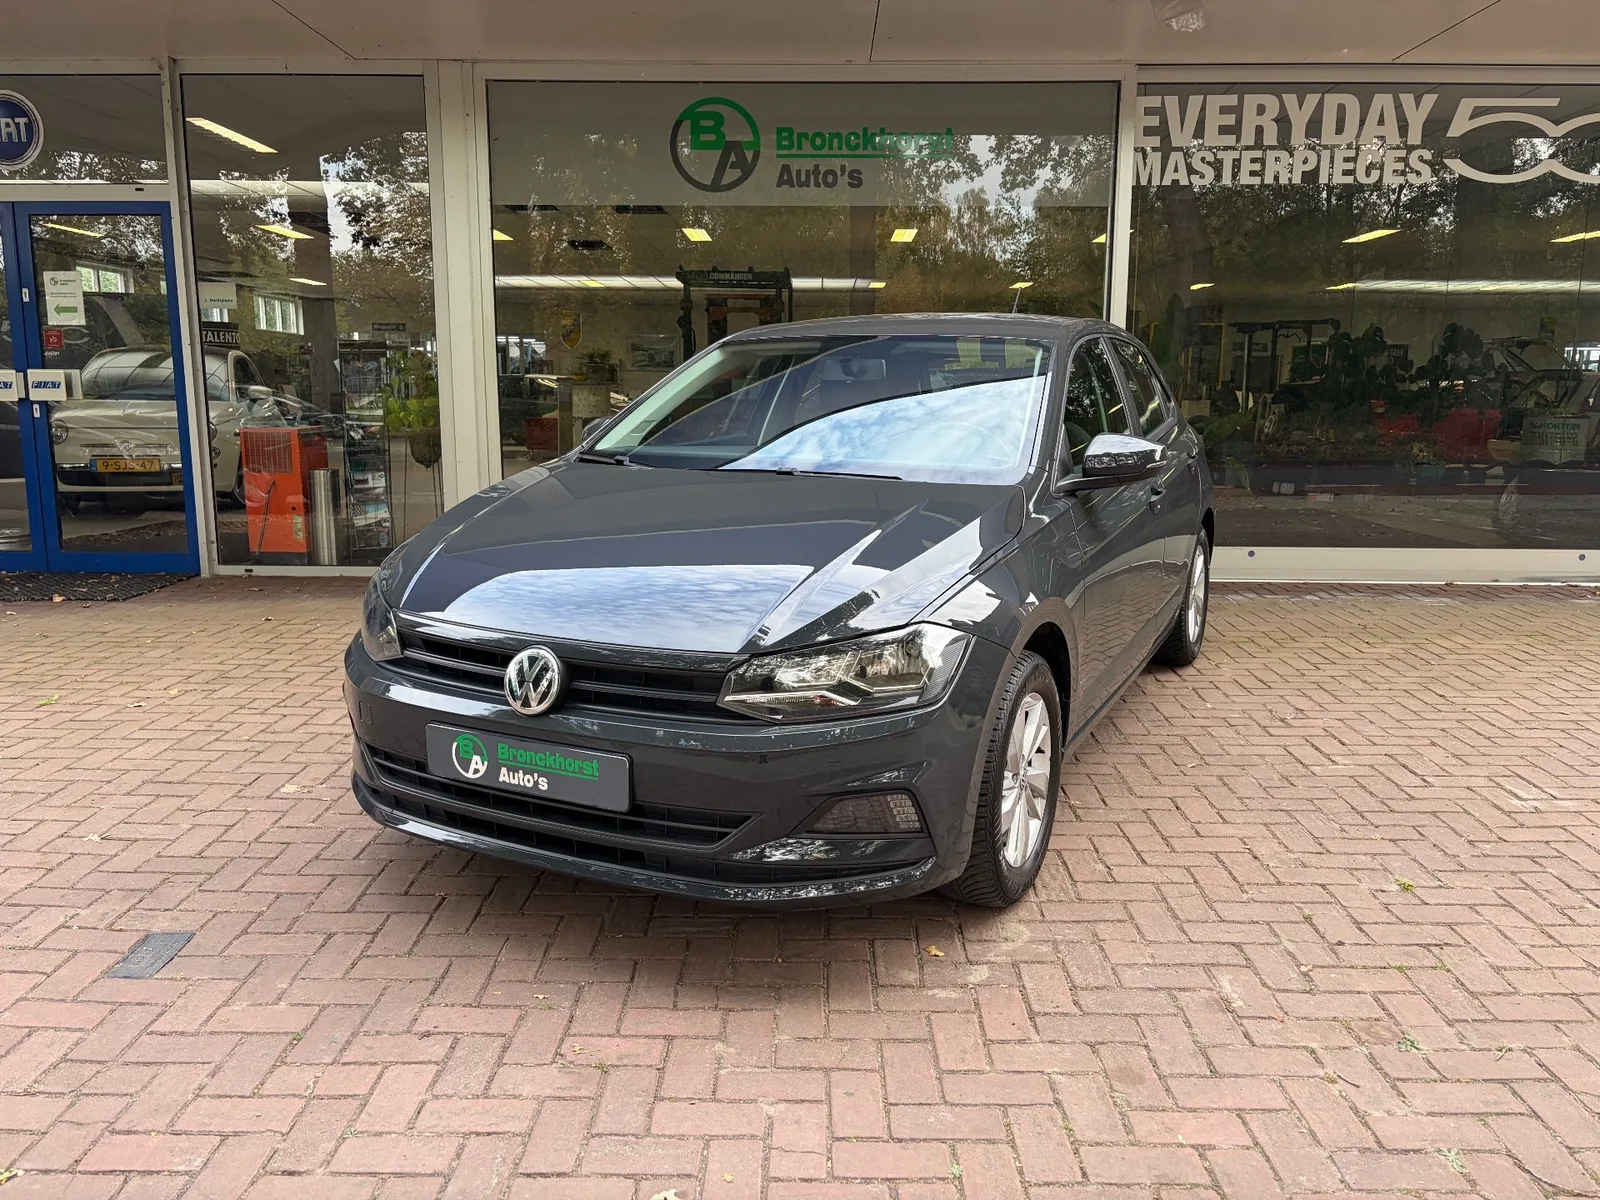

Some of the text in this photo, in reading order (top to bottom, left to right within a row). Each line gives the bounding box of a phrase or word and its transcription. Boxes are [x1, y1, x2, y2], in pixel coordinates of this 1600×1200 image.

[0, 117, 29, 142] AT
[1134, 93, 1439, 147] EVERYDAY
[775, 126, 954, 152] Bronckhorst
[775, 163, 864, 189] Auto's
[1132, 149, 1433, 186] MASTERPIECES
[709, 272, 753, 281] COMMANDER
[202, 331, 241, 345] TALENTO
[101, 460, 154, 471] 9-SJS-47
[496, 742, 599, 776] Bronckhorst
[498, 767, 549, 791] Auto's
